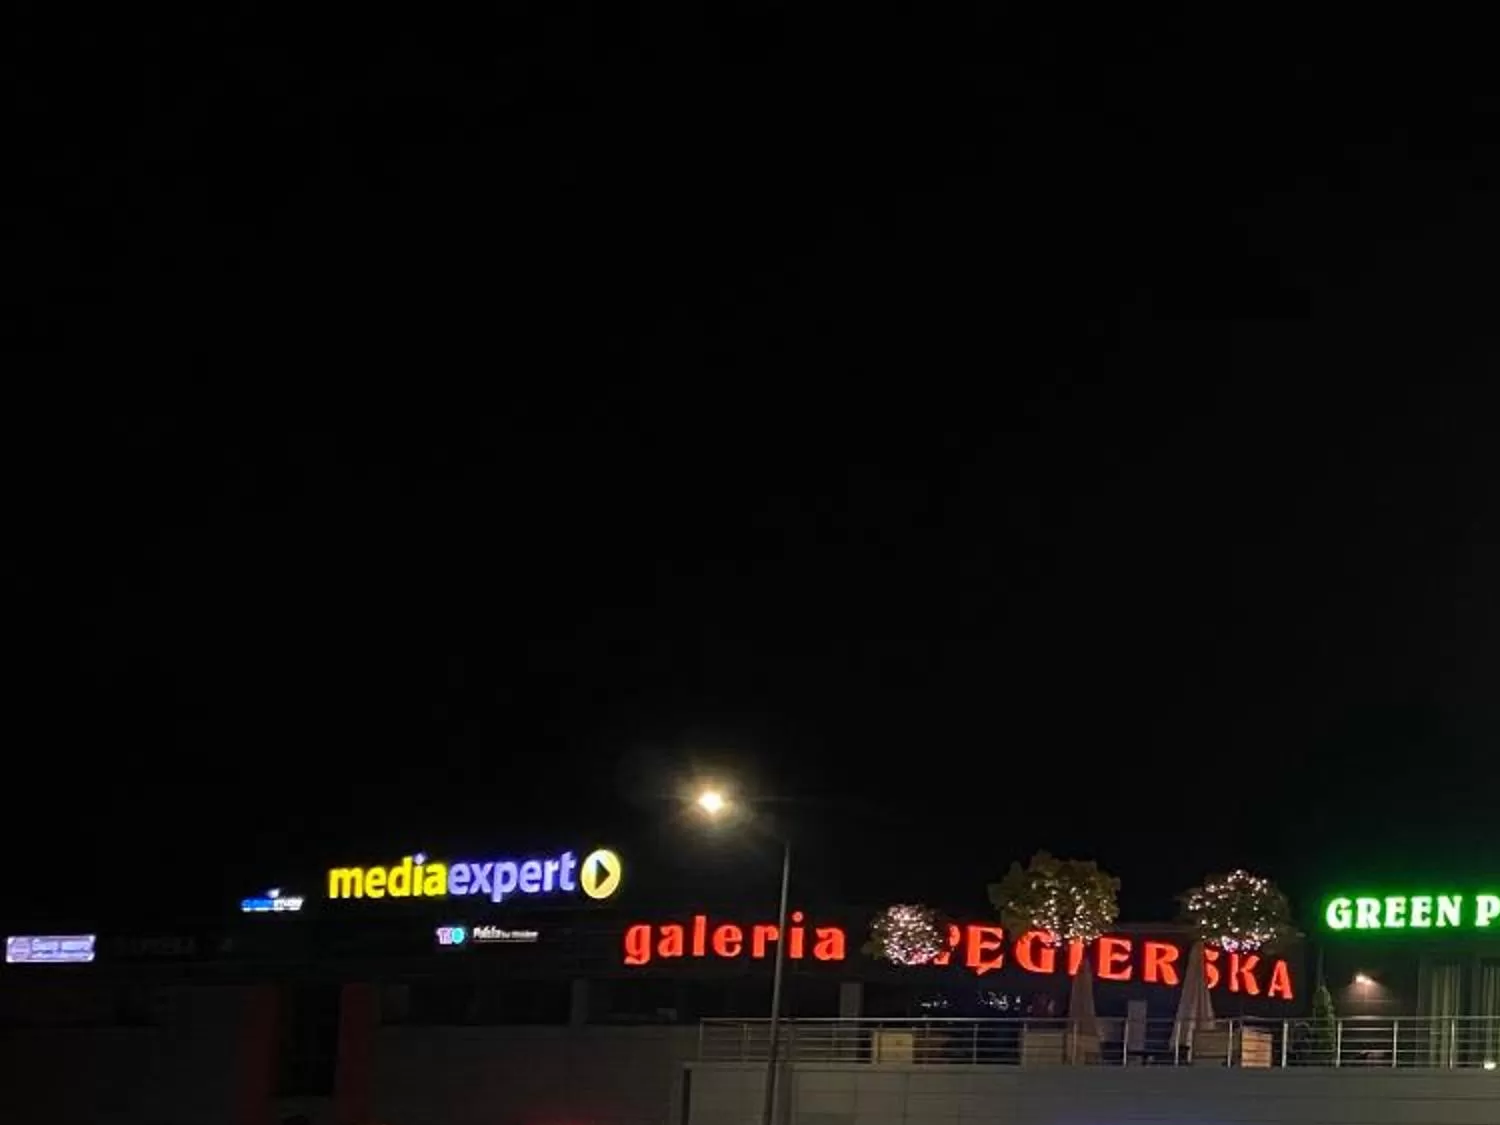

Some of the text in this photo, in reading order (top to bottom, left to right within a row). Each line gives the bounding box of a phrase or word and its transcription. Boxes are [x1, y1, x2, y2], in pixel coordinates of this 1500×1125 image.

[329, 853, 576, 902] mediaexpert
[1326, 896, 1463, 930] GREEN
[624, 911, 1294, 1000] galeria ĘGIERSKA
